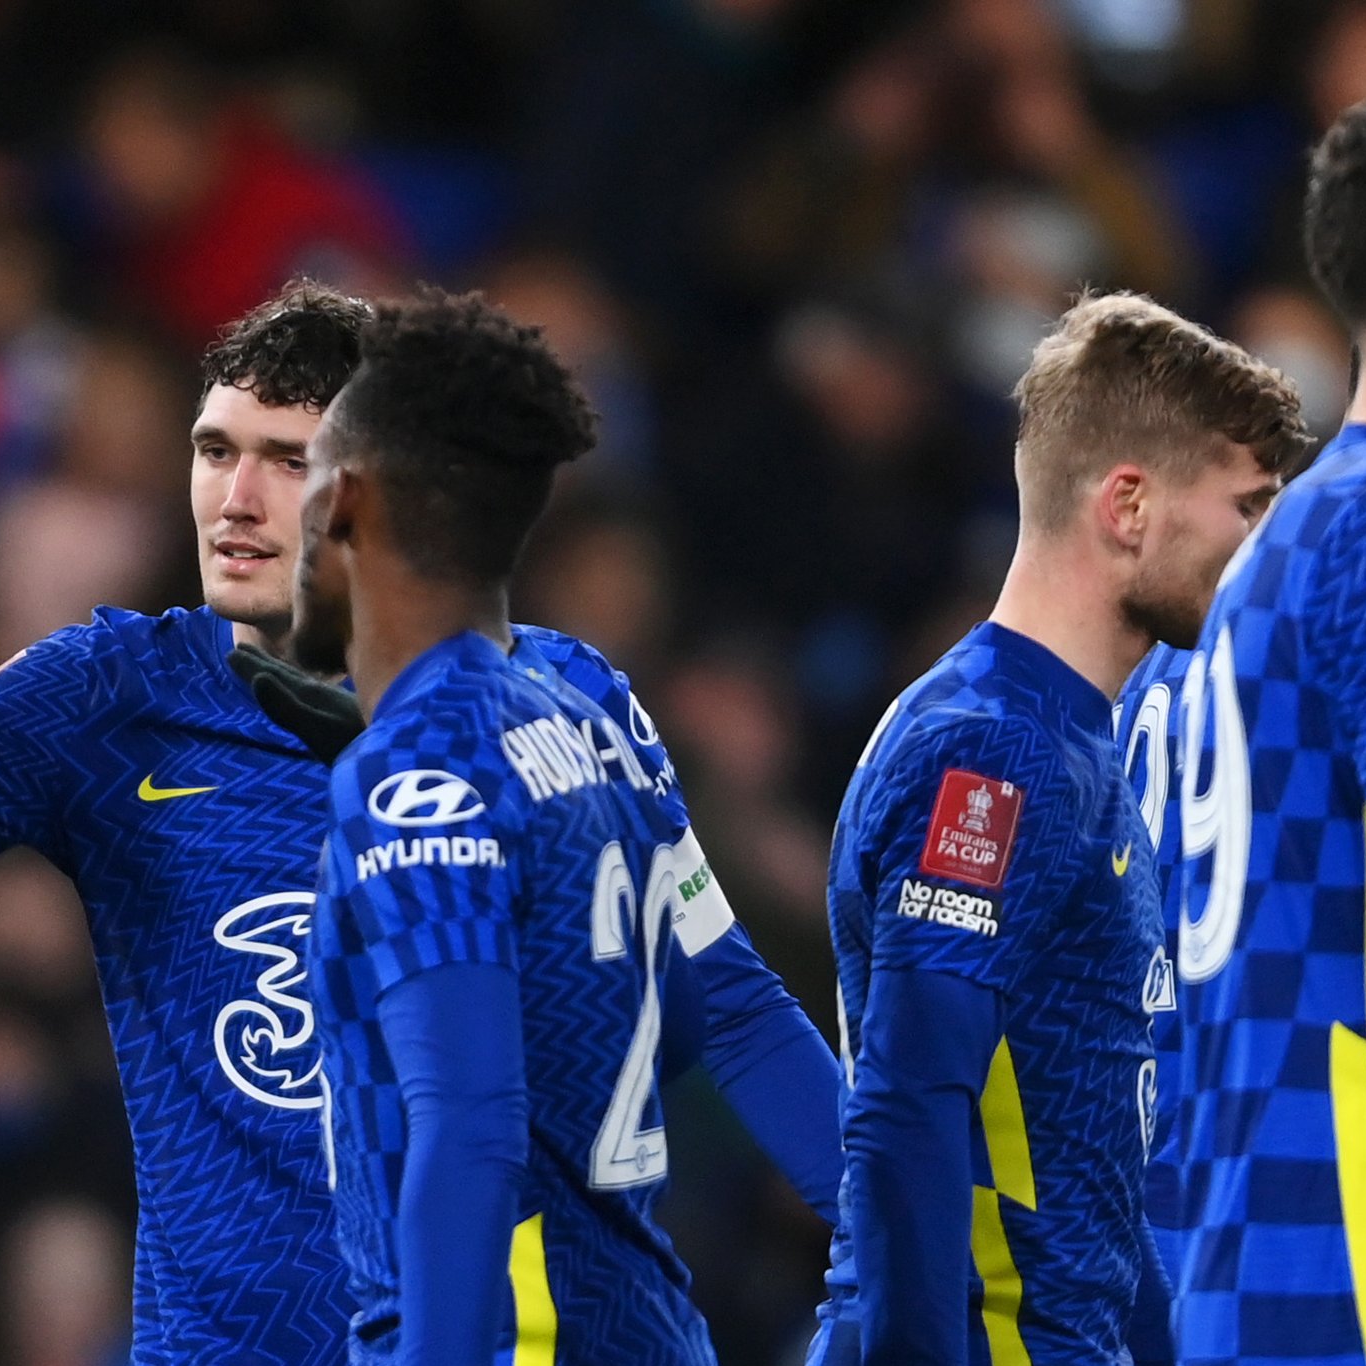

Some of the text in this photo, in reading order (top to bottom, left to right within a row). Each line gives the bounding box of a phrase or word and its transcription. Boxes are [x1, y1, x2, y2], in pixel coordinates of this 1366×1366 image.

[937, 839, 996, 865] FA CUP
[941, 826, 998, 852] Emirates
[901, 879, 993, 917] No room
[928, 903, 998, 937] racism
